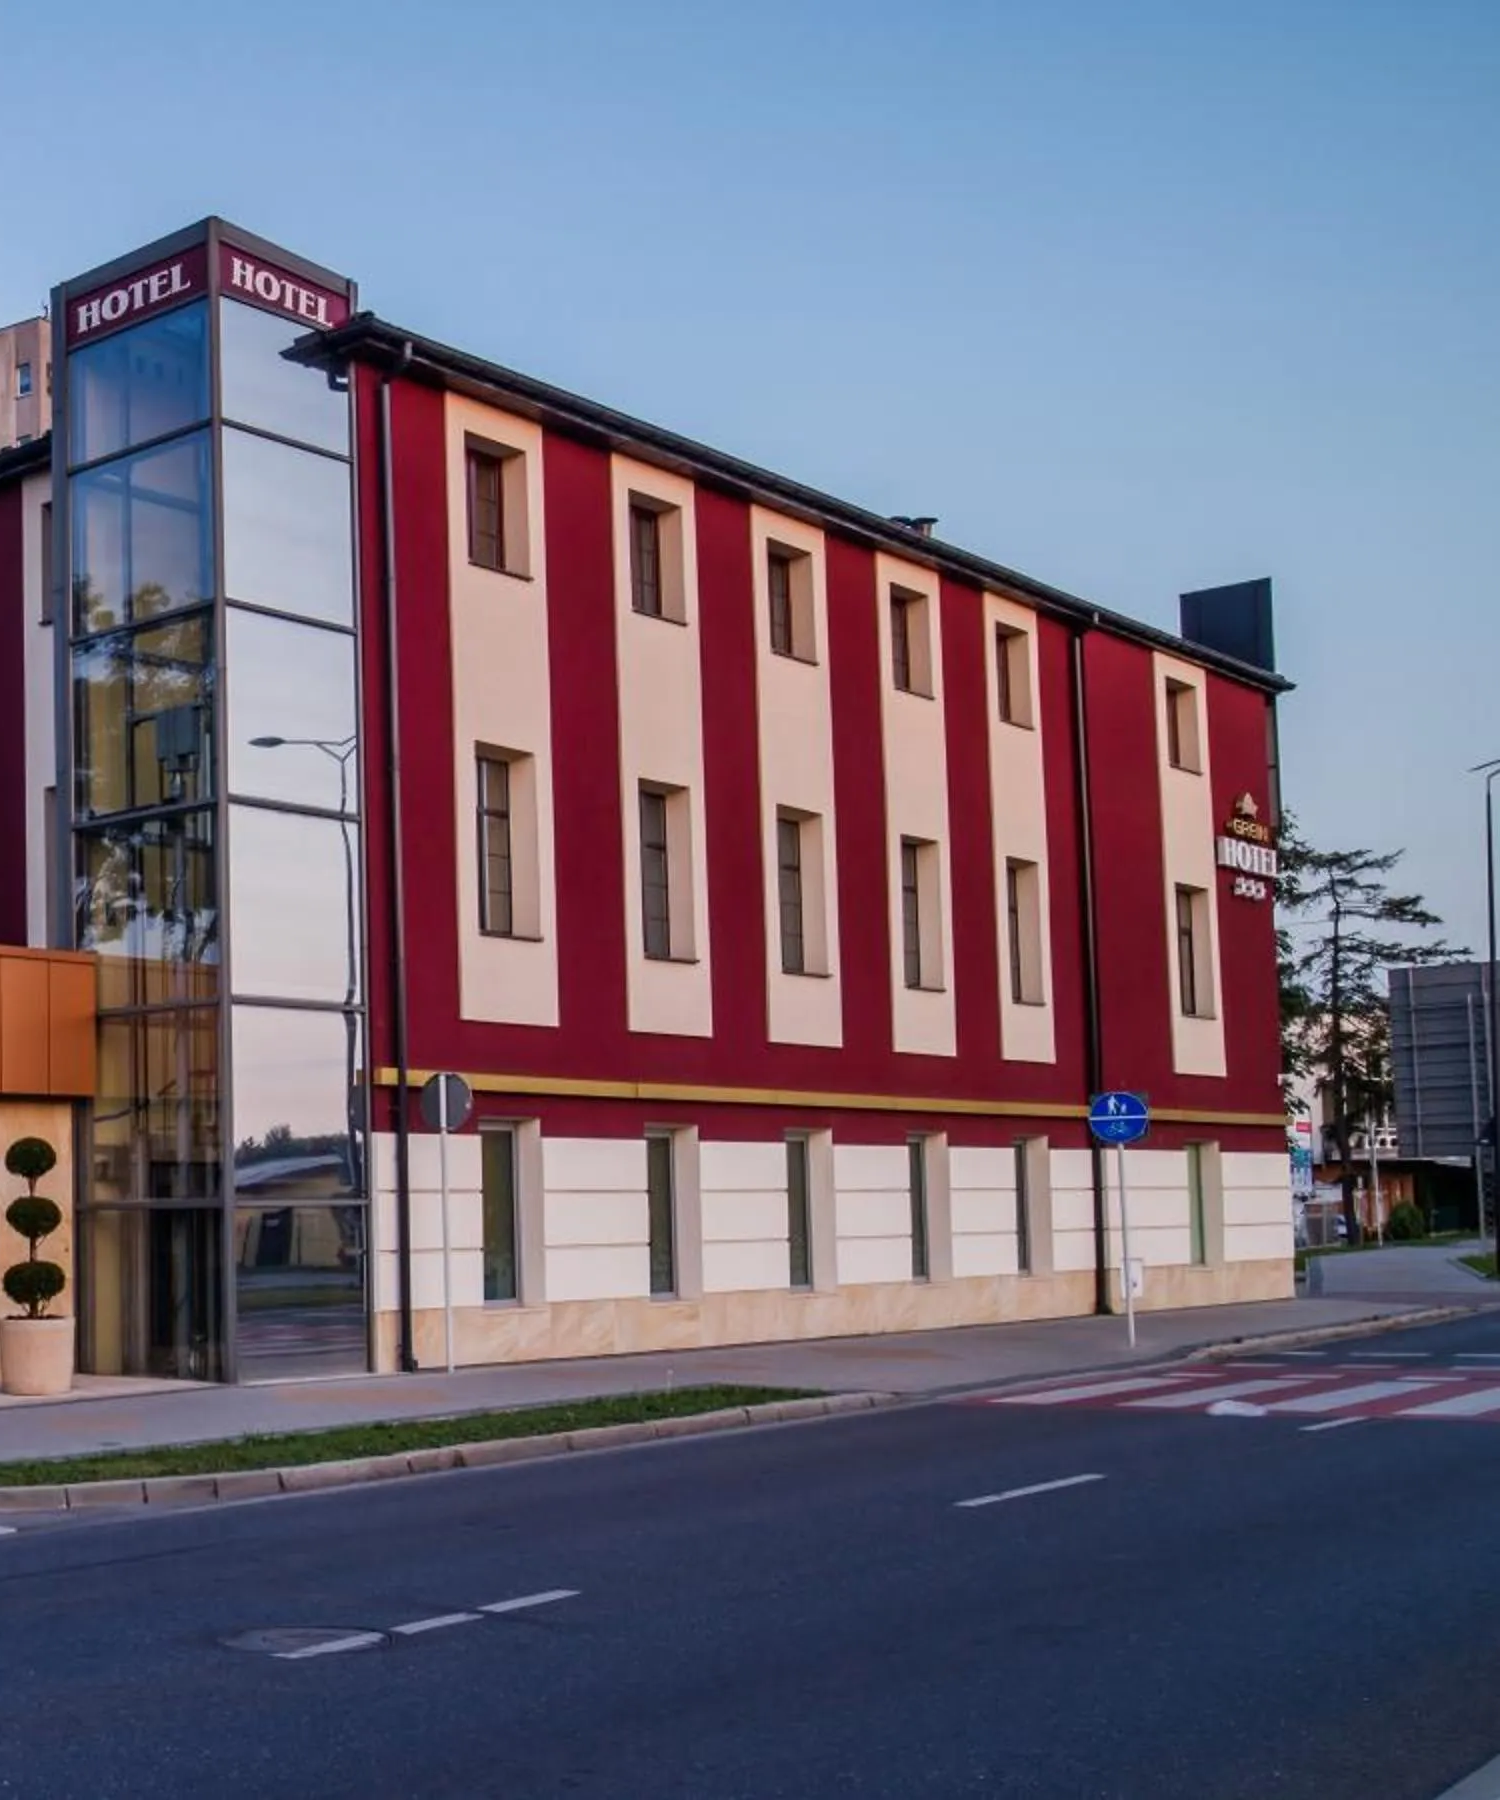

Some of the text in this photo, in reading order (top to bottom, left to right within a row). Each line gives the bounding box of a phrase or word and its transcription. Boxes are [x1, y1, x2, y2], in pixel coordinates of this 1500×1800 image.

[76, 263, 191, 333] HOTEL
[231, 256, 333, 328] HOTEL
[1217, 836, 1278, 878] HOTEL
